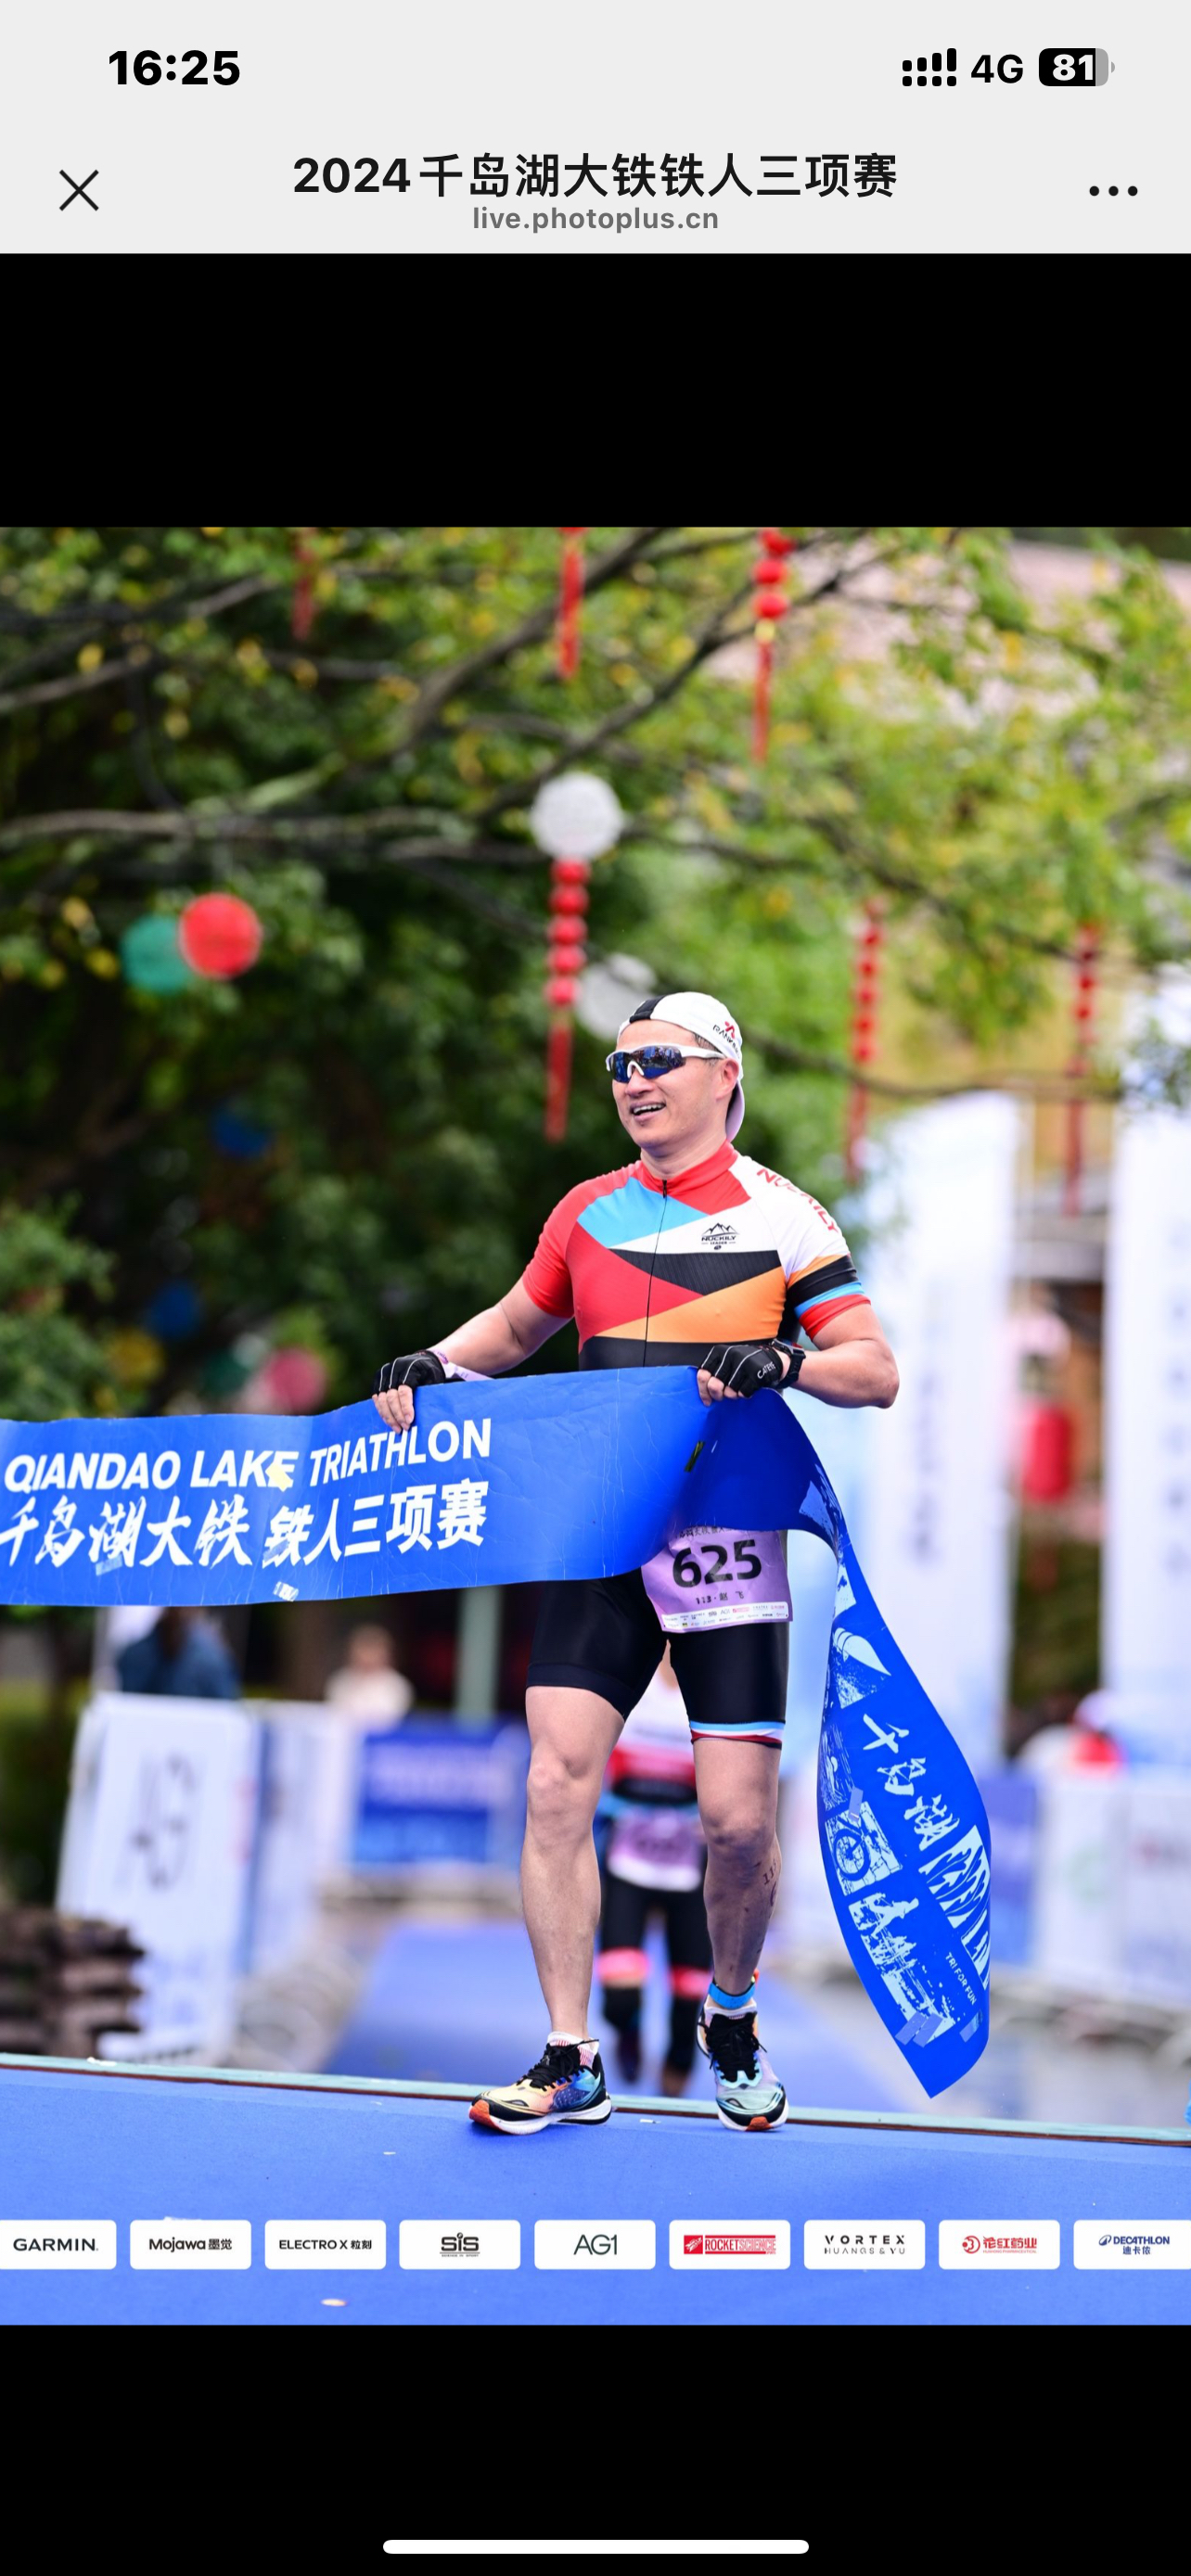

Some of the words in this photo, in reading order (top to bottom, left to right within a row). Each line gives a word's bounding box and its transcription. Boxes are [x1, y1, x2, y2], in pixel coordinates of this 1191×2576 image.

[4, 1450, 181, 1494] QIANDAO
[190, 1449, 299, 1489] LAKE
[310, 1418, 492, 1486] TRIATHLON
[263, 1478, 489, 1568] 铁人三项赛
[672, 1539, 762, 1588] 625
[945, 1951, 958, 1970] TRI
[954, 1968, 968, 1988] FOR
[965, 1985, 978, 2006] FUN
